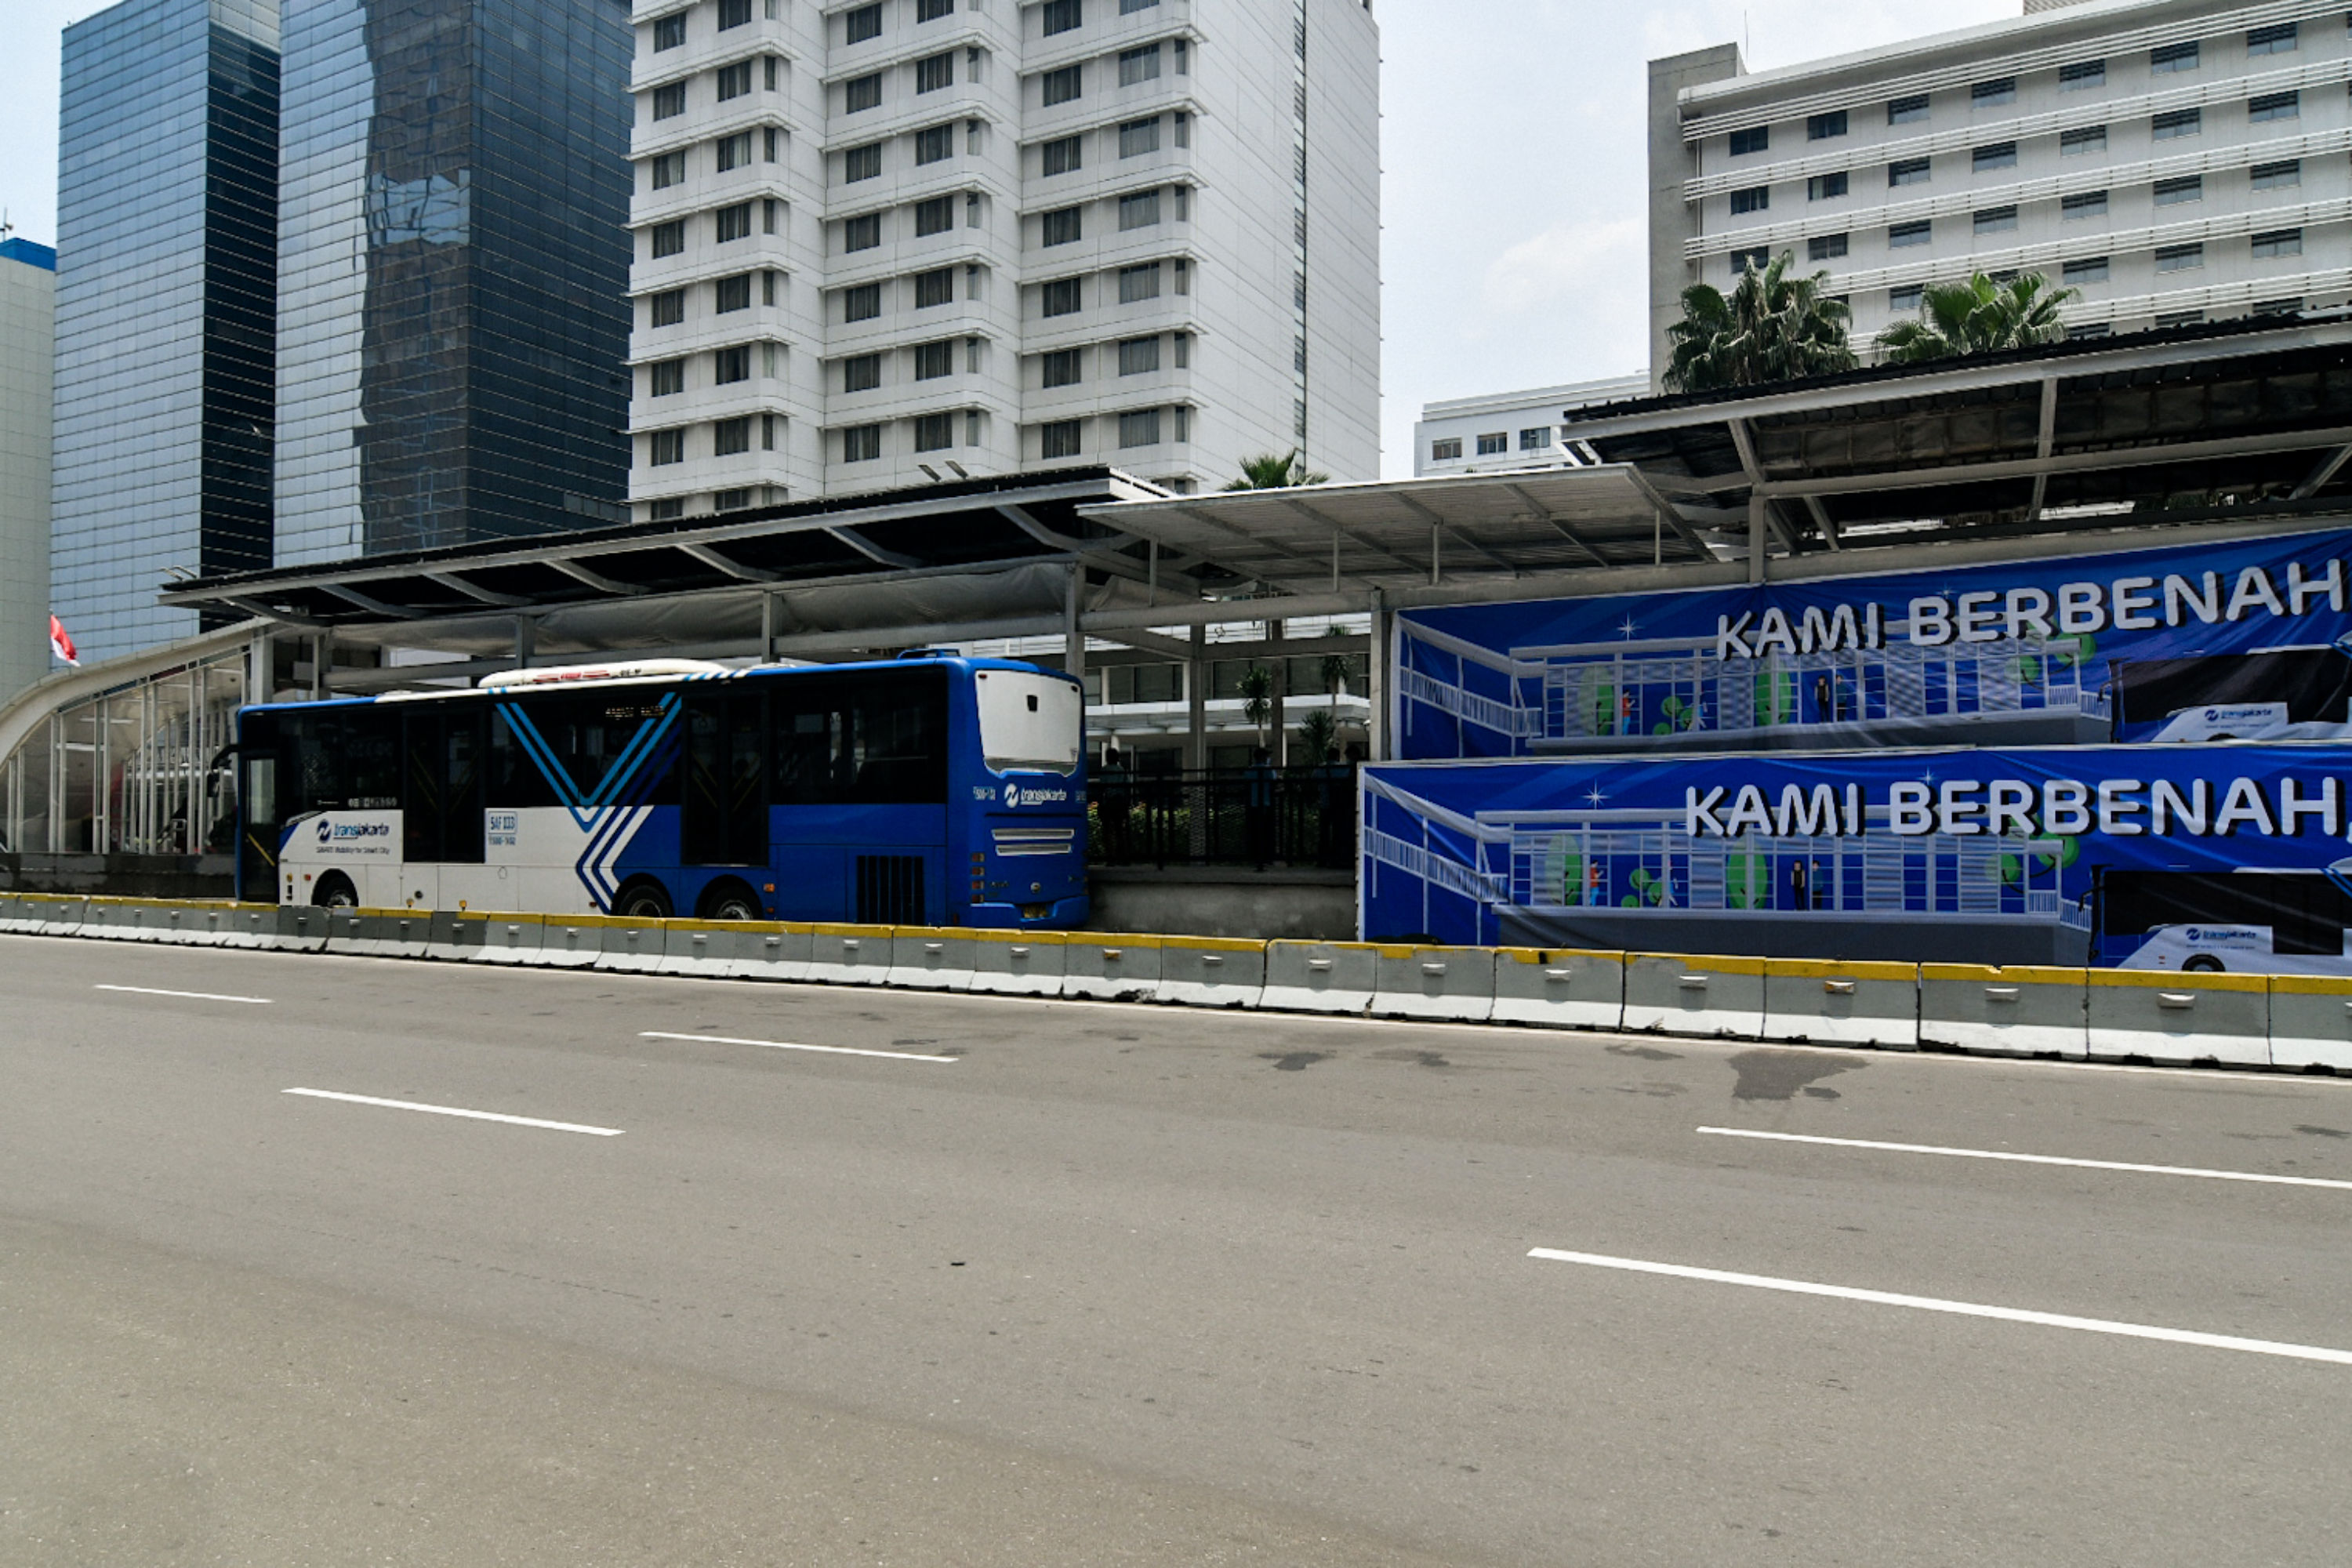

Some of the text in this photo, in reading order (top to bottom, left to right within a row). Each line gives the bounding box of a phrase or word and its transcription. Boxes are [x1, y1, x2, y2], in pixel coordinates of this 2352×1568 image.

[1717, 558, 2343, 661] KAMI BERBENAH
[333, 822, 390, 840] transjakarta
[1686, 782, 1858, 837] KAMI
